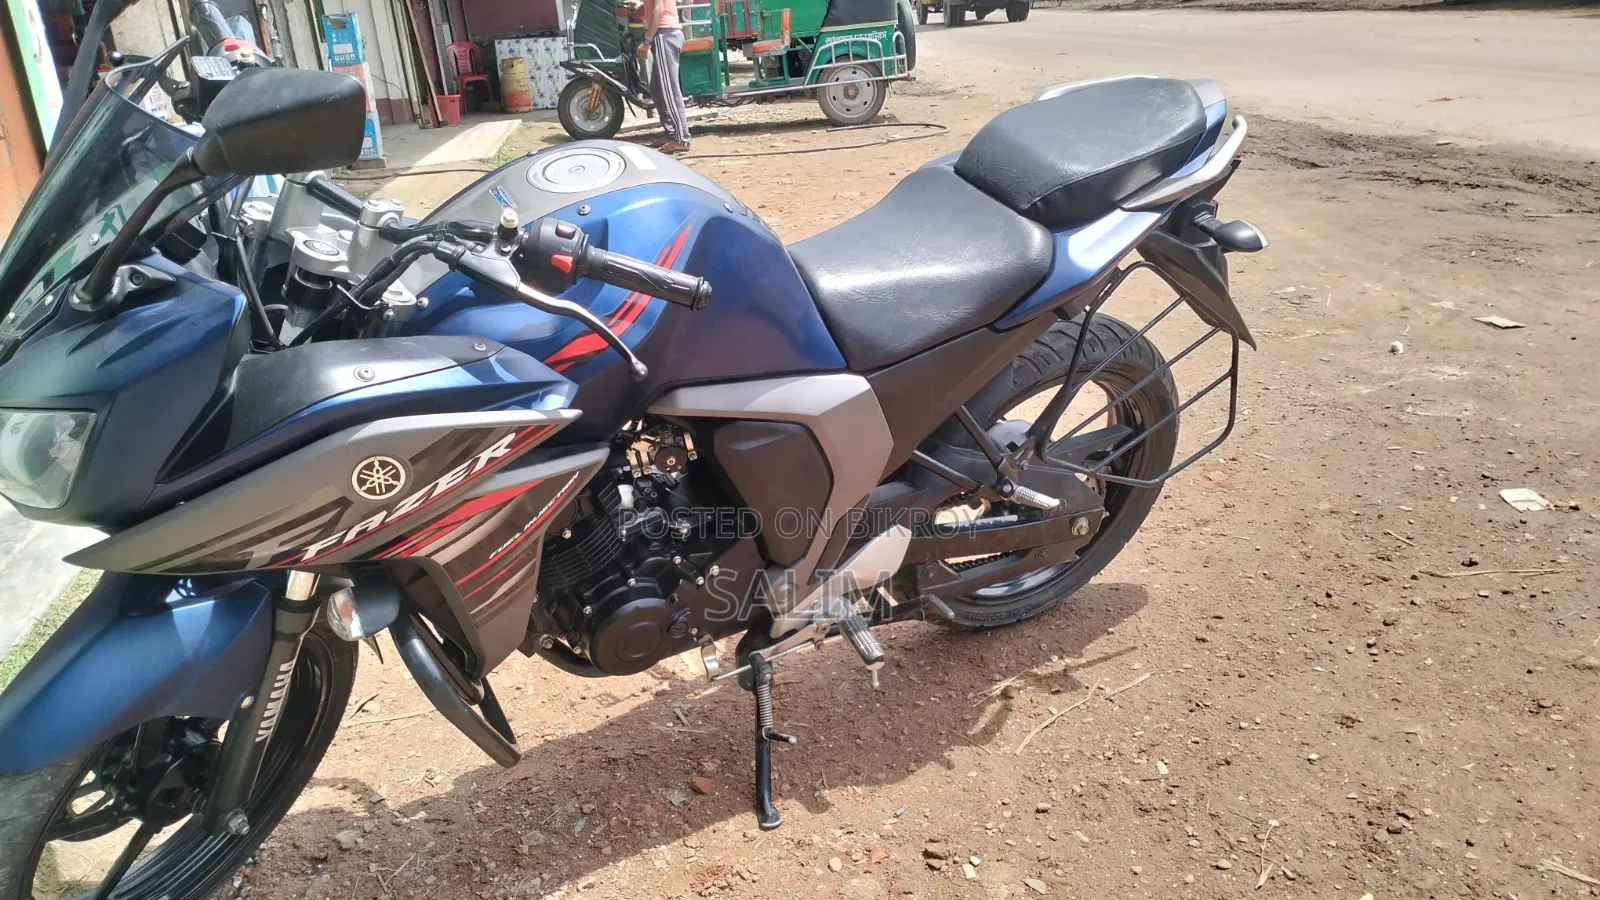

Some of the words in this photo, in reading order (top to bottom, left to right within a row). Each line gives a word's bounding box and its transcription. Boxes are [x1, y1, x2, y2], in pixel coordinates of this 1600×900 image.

[300, 432, 516, 562] FAZER
[488, 532, 522, 559] FUEL
[524, 471, 579, 531] INJECTION
